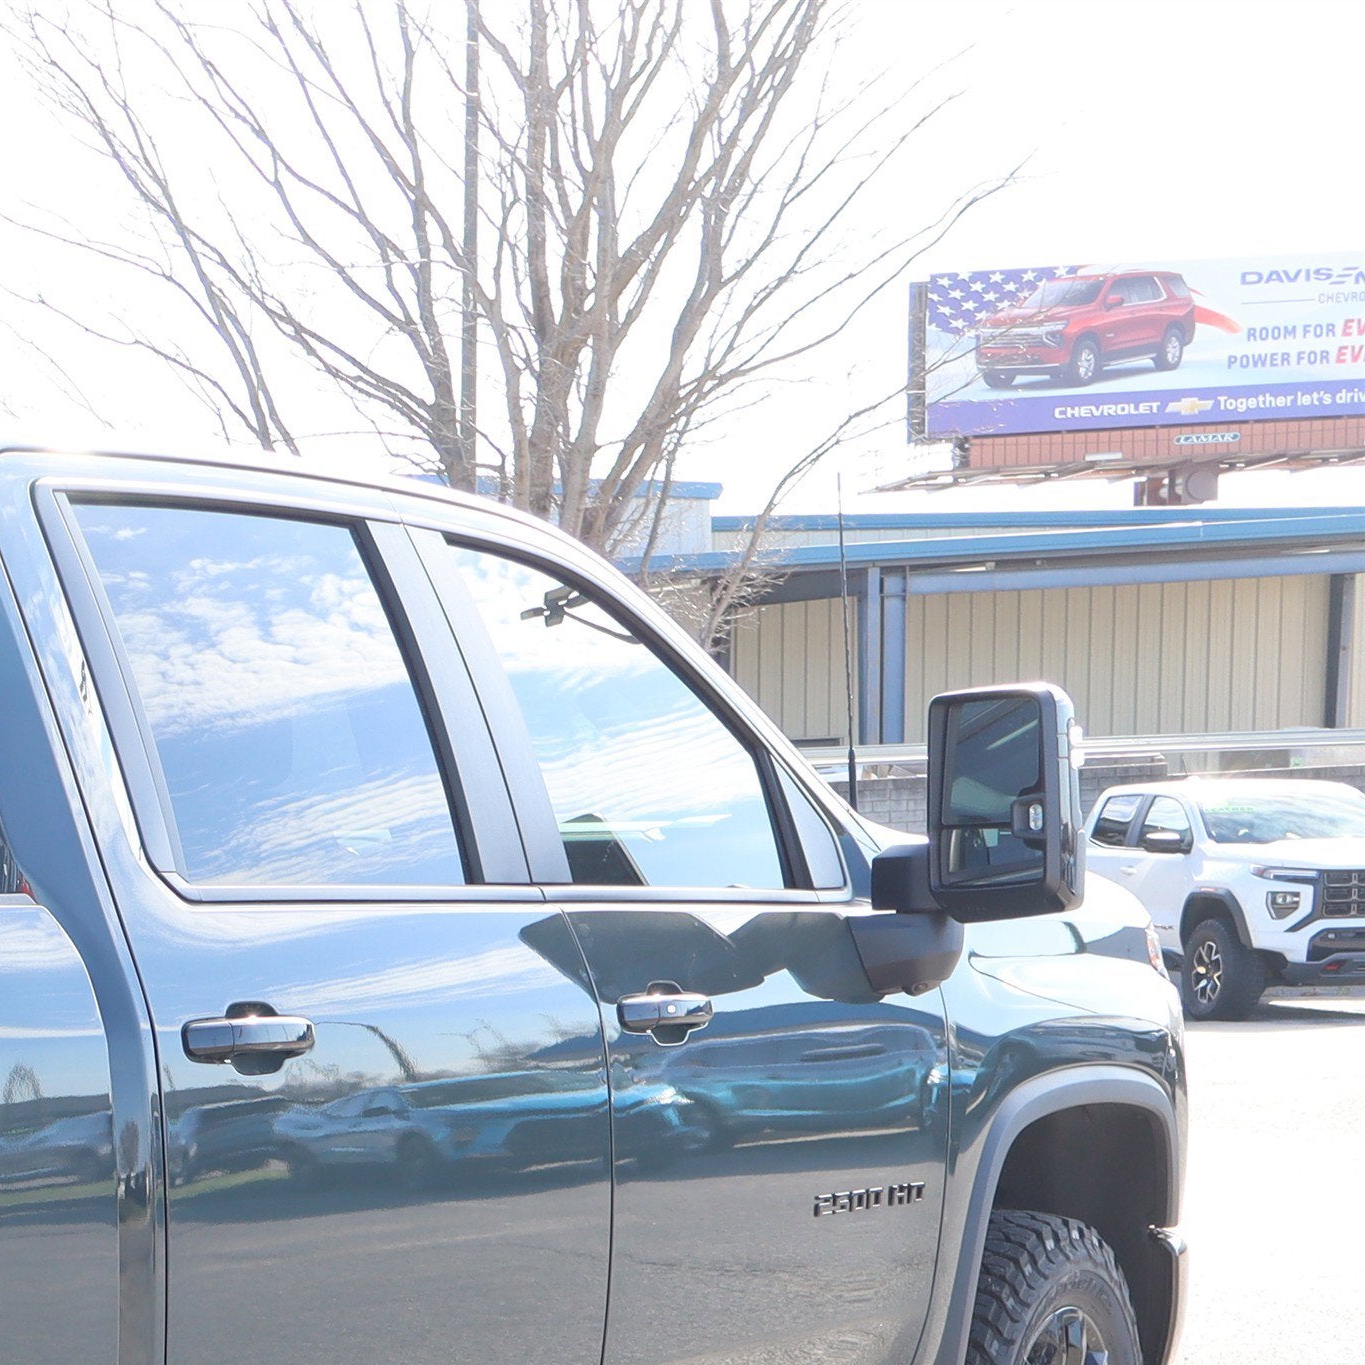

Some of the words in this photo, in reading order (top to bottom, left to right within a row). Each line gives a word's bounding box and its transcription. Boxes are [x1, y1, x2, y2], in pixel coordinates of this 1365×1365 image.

[1246, 325, 1297, 342] ROOM
[1302, 323, 1336, 339] FOR
[1227, 352, 1291, 370] POWER
[1297, 350, 1330, 366] FOR
[1335, 345, 1365, 364] EV
[1054, 402, 1161, 419] CHEVROLET
[1217, 392, 1294, 412] Together
[1297, 389, 1332, 406] let's
[1179, 433, 1235, 444] LAMAR
[813, 1187, 884, 1217] 2500
[887, 1181, 926, 1207] HD
